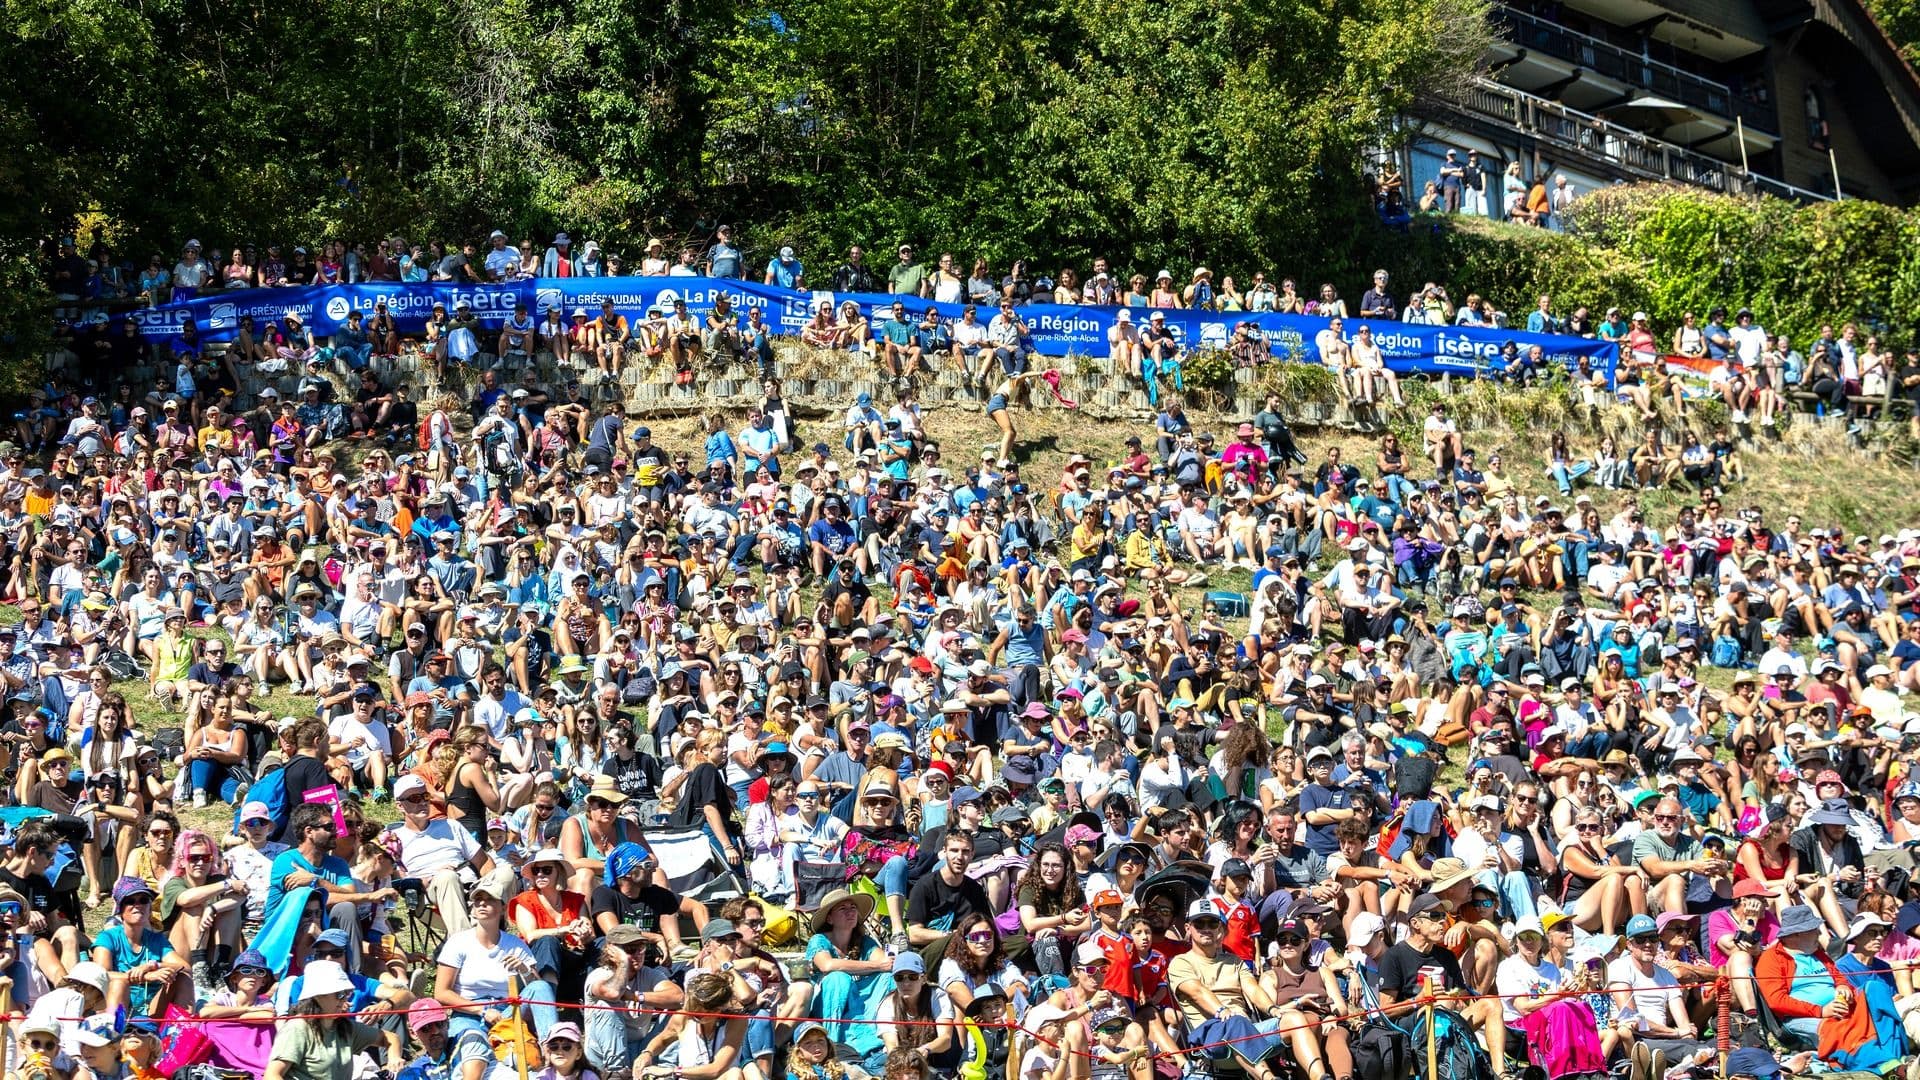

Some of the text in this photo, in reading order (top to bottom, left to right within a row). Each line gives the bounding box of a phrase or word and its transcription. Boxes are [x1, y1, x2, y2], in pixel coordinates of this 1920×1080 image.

[354, 295, 372, 310] La
[684, 289, 768, 308] La Rgion
[1041, 315, 1099, 334] Région
[1438, 332, 1499, 358] isère
